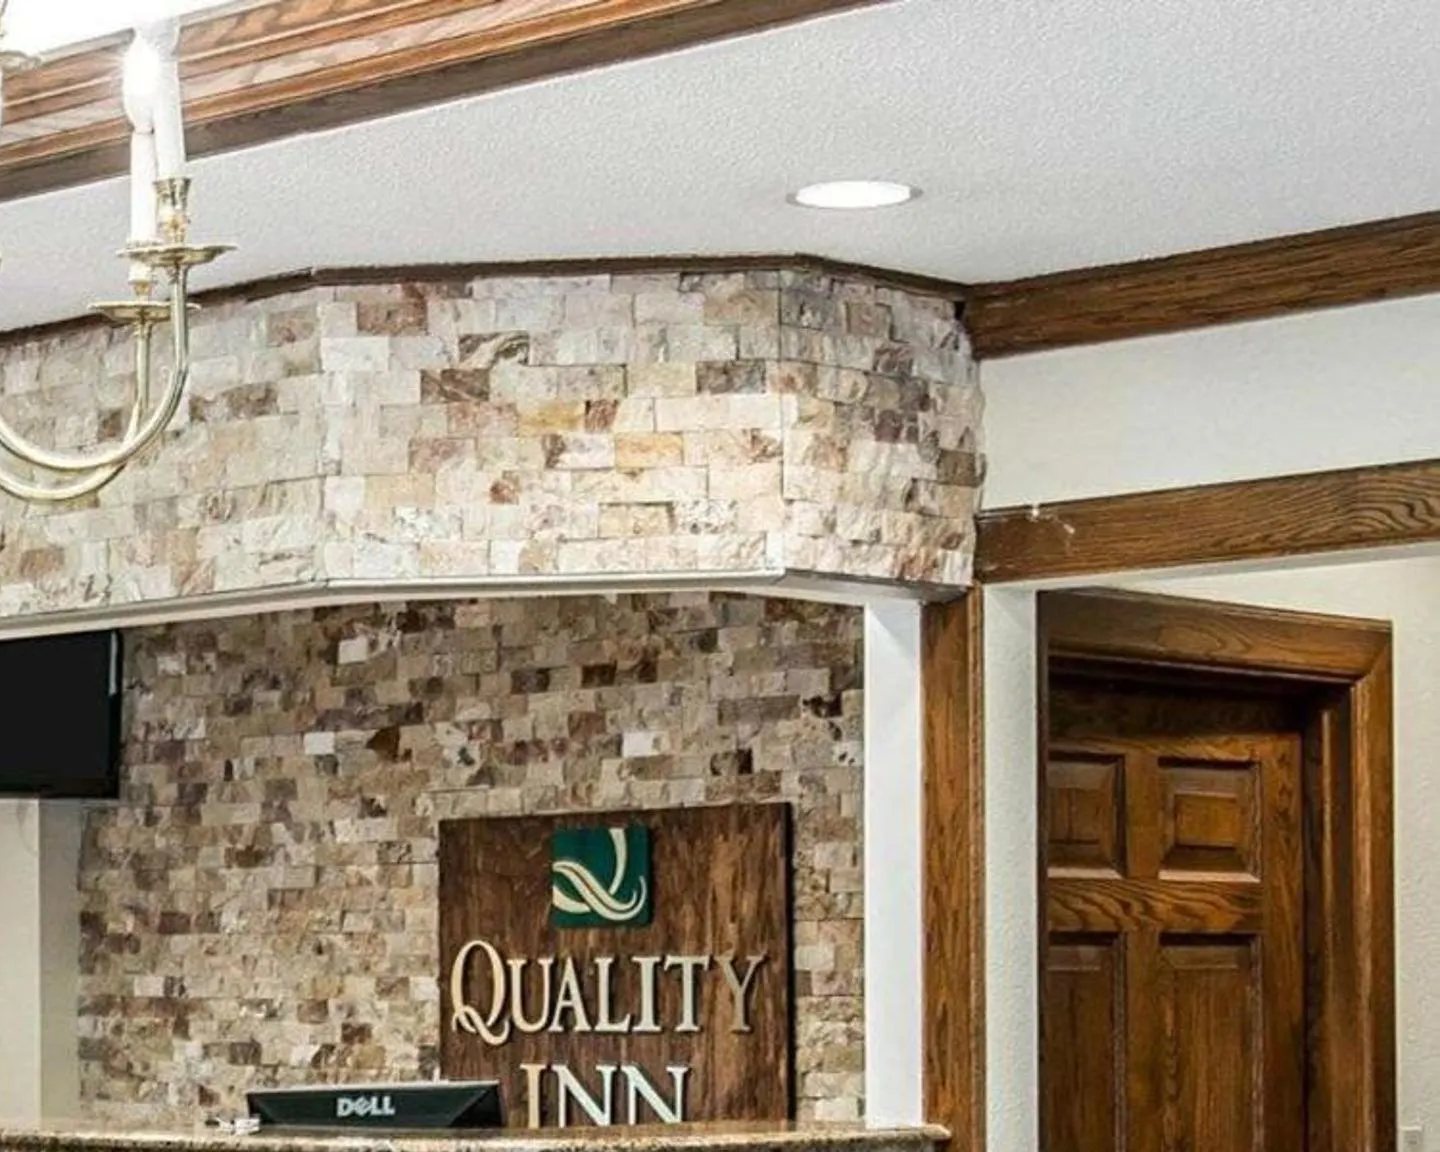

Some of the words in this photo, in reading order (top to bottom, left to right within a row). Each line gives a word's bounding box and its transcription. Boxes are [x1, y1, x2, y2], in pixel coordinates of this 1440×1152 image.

[451, 939, 767, 1046] QUALITY
[336, 1095, 396, 1118] DELL
[520, 1062, 690, 1128] INN
